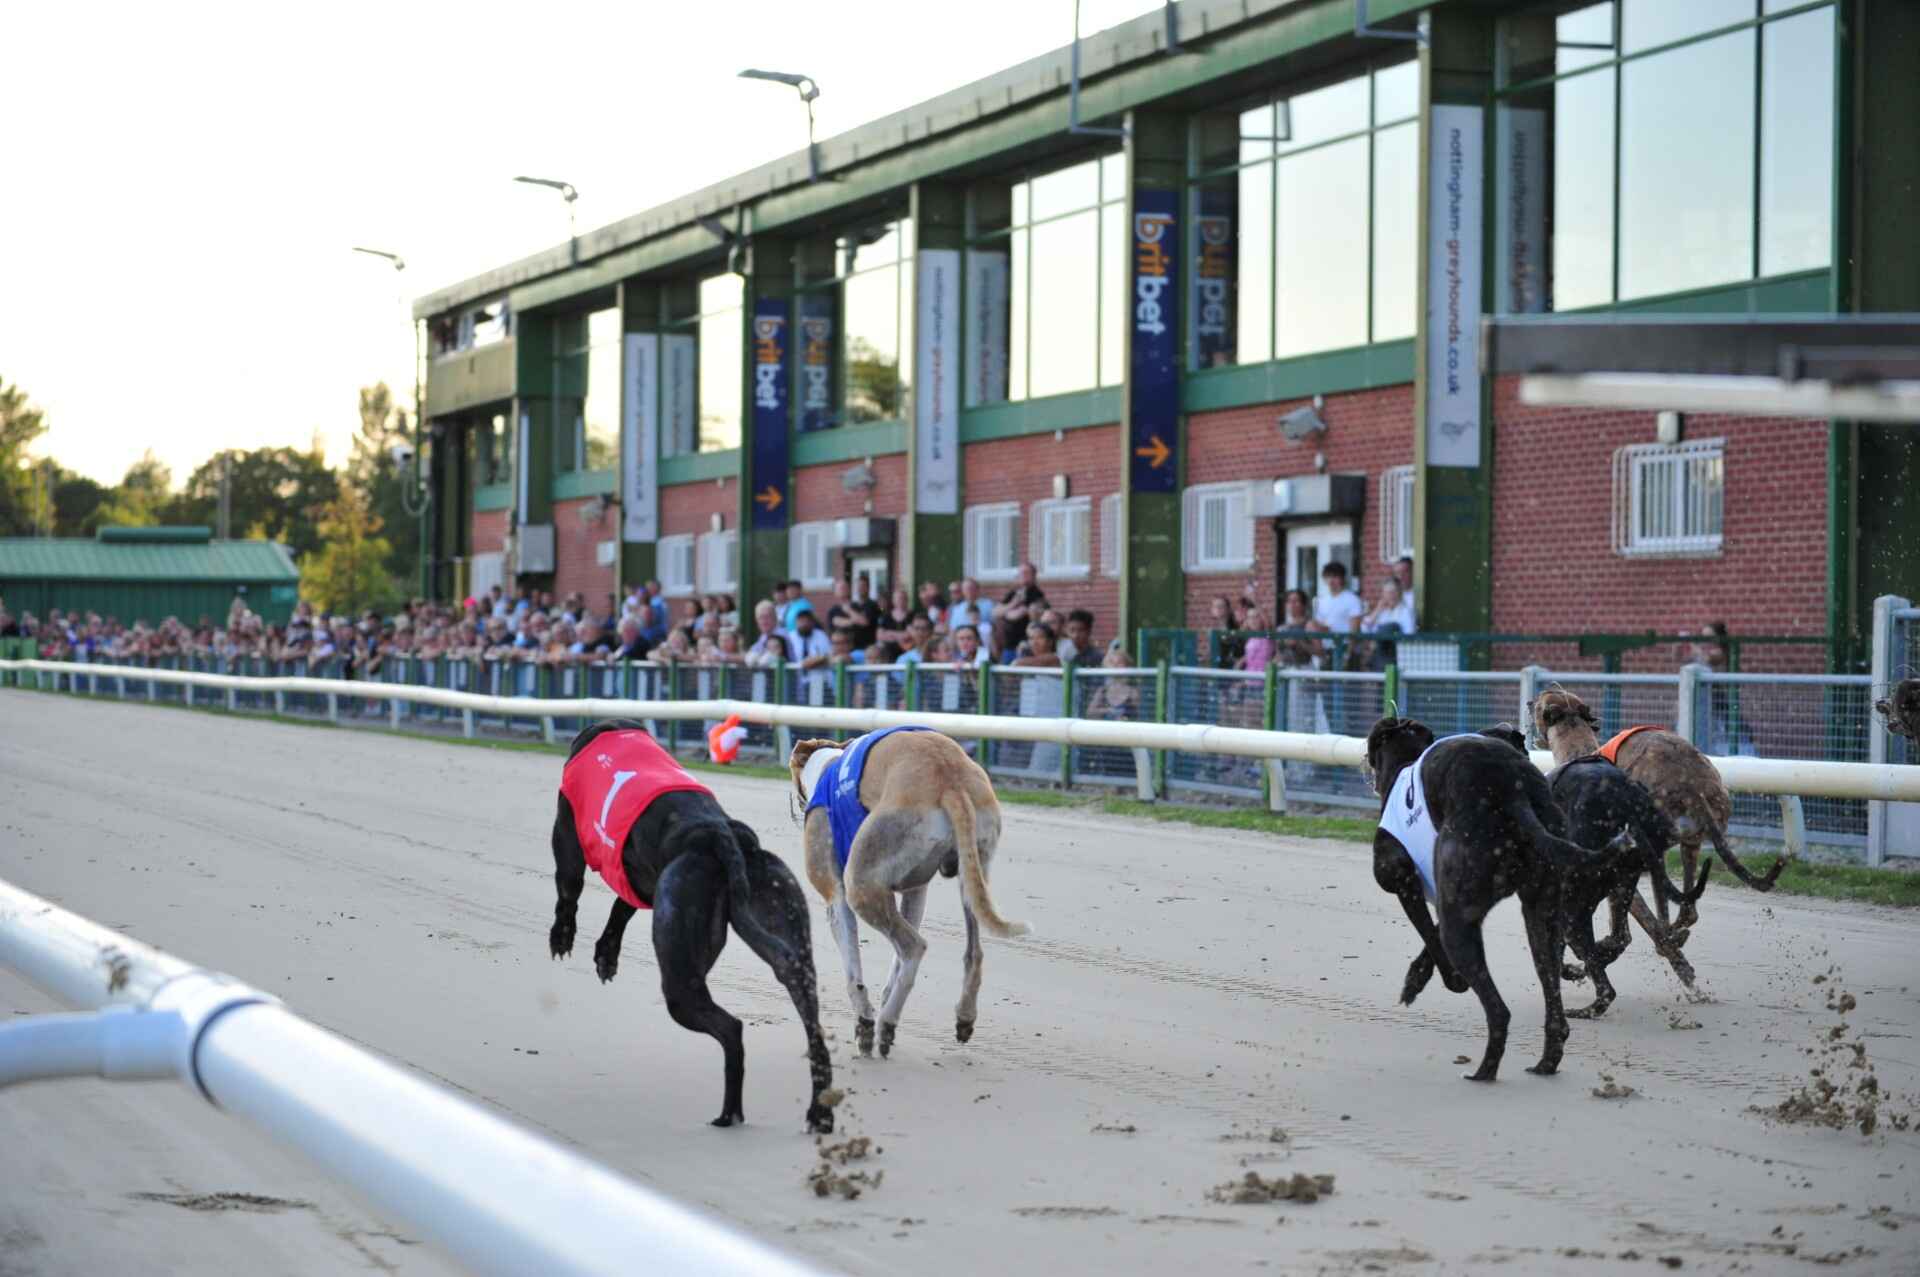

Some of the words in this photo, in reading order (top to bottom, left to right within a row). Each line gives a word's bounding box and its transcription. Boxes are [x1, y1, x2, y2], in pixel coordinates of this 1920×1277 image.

[1135, 211, 1177, 335] britbet
[1445, 128, 1463, 396] nottingham-greyhounds.co.uk
[754, 314, 787, 410] britbet
[600, 770, 638, 829] 1
